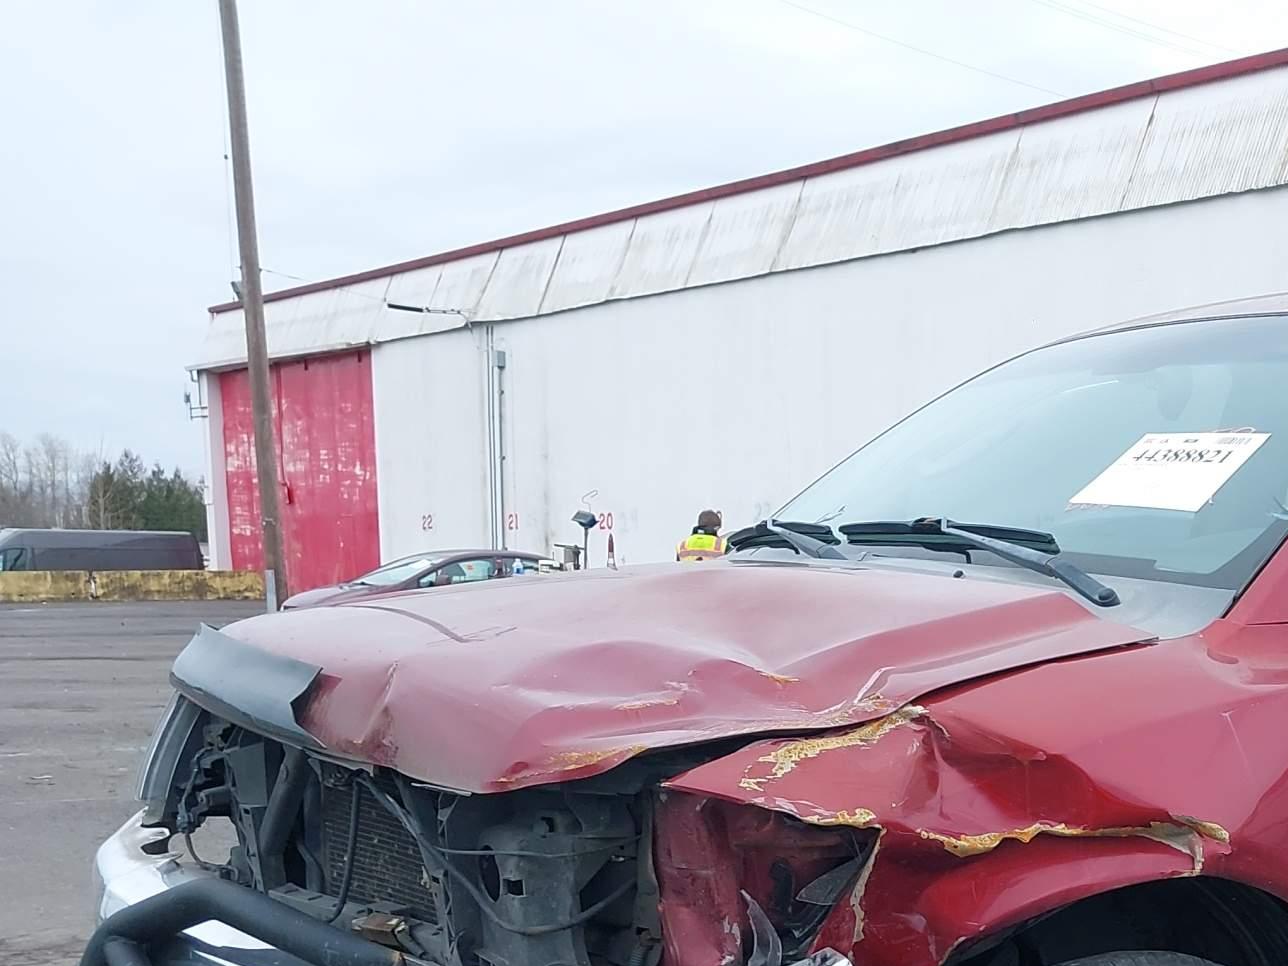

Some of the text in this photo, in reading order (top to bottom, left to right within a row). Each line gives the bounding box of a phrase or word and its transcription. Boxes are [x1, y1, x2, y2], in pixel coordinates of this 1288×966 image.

[1132, 448, 1234, 464] 44388821
[422, 514, 433, 530] 22
[508, 514, 519, 530] 21
[599, 512, 614, 530] 20
